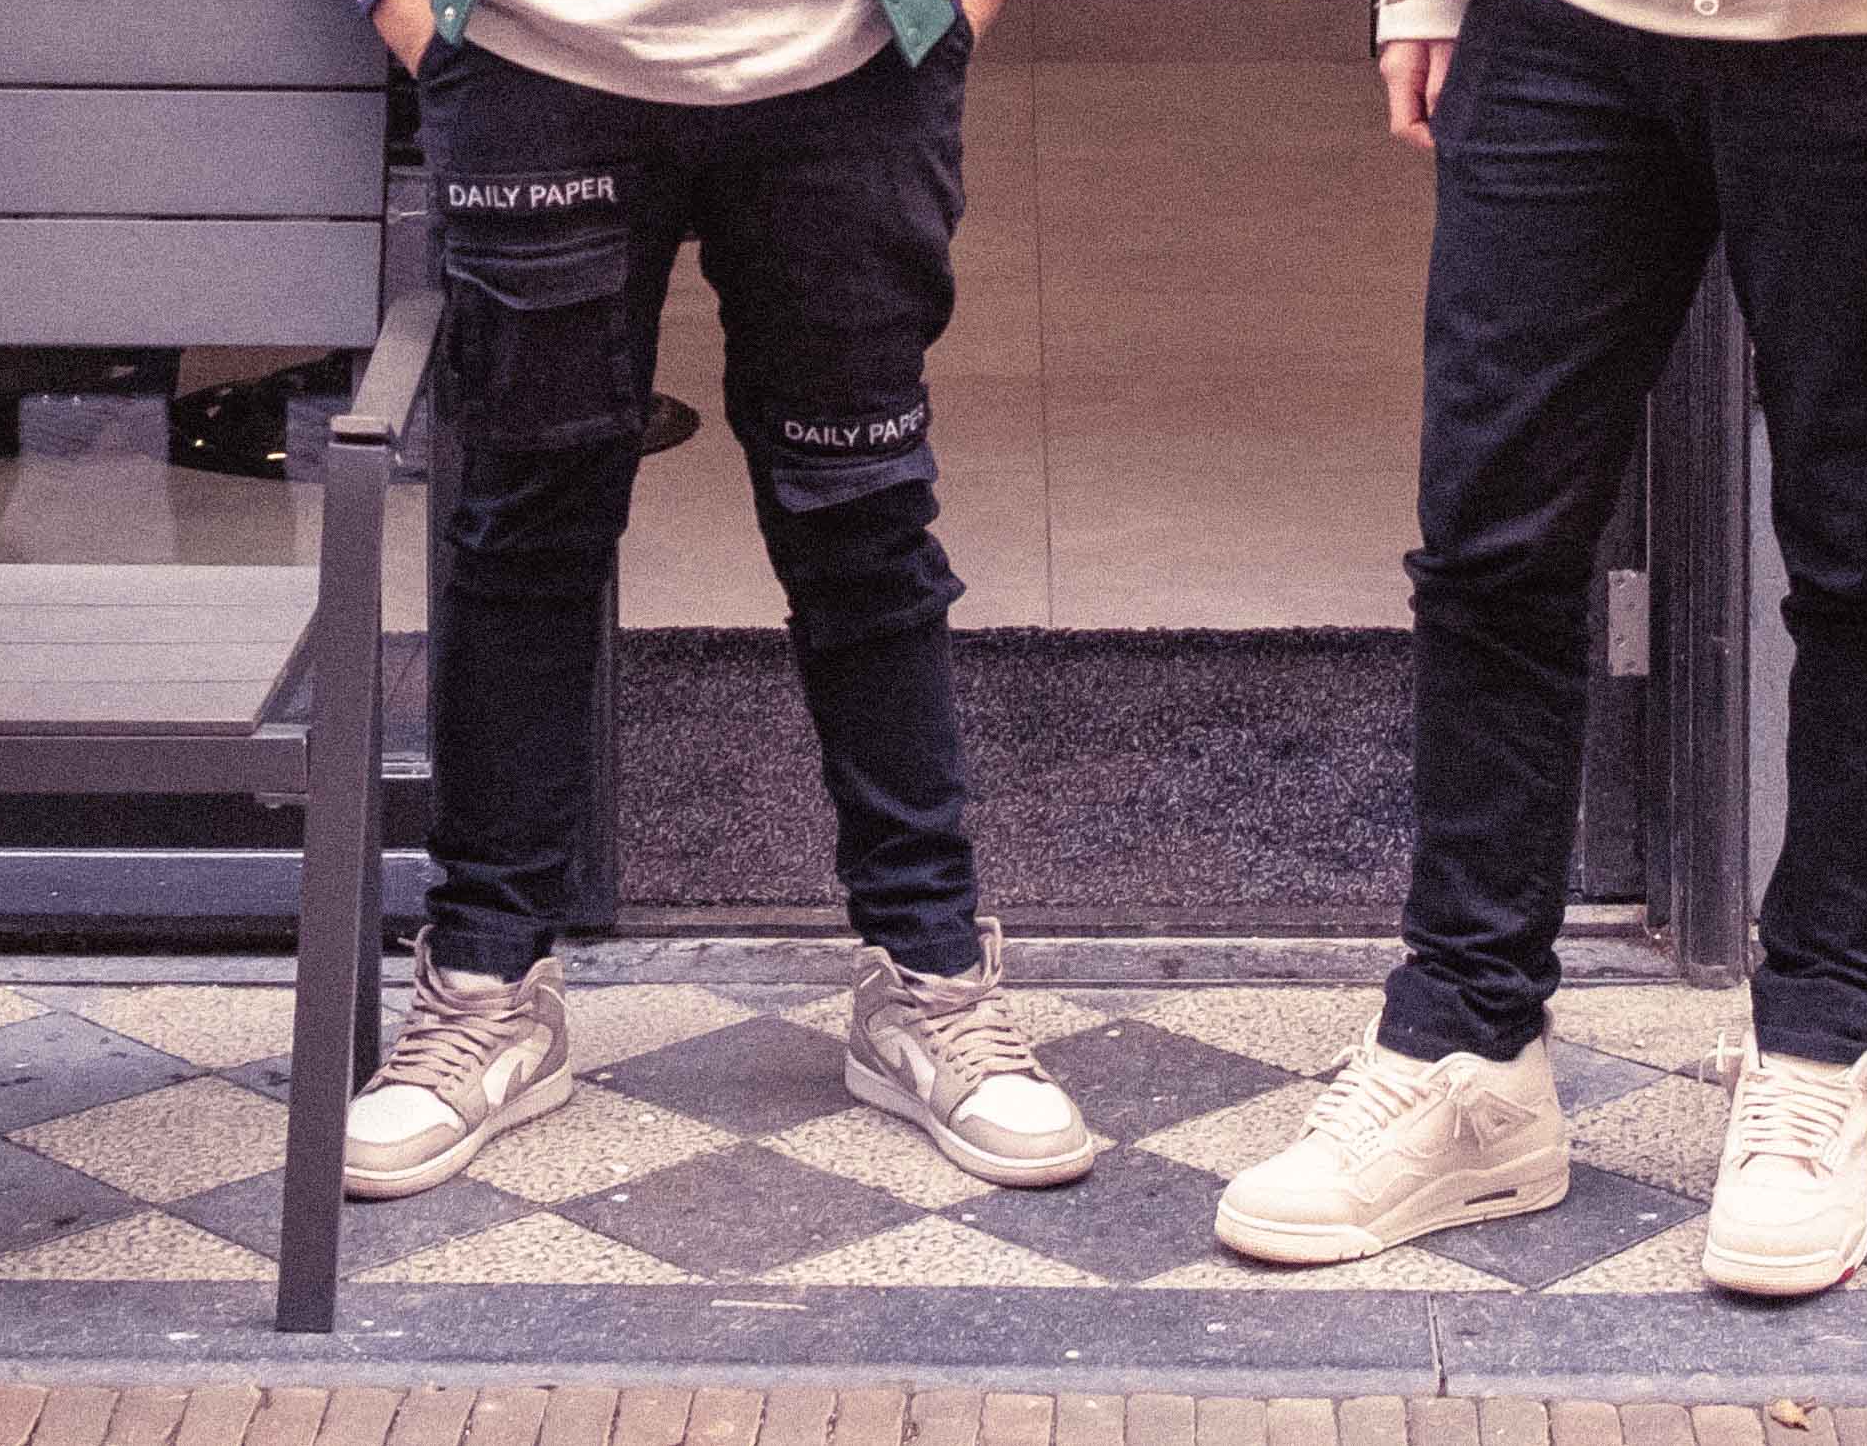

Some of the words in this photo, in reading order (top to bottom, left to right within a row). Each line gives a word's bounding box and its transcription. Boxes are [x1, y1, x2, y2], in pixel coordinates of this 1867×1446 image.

[448, 183, 521, 208] DAILY
[529, 175, 619, 208] PAPER
[784, 420, 861, 448] DAILY
